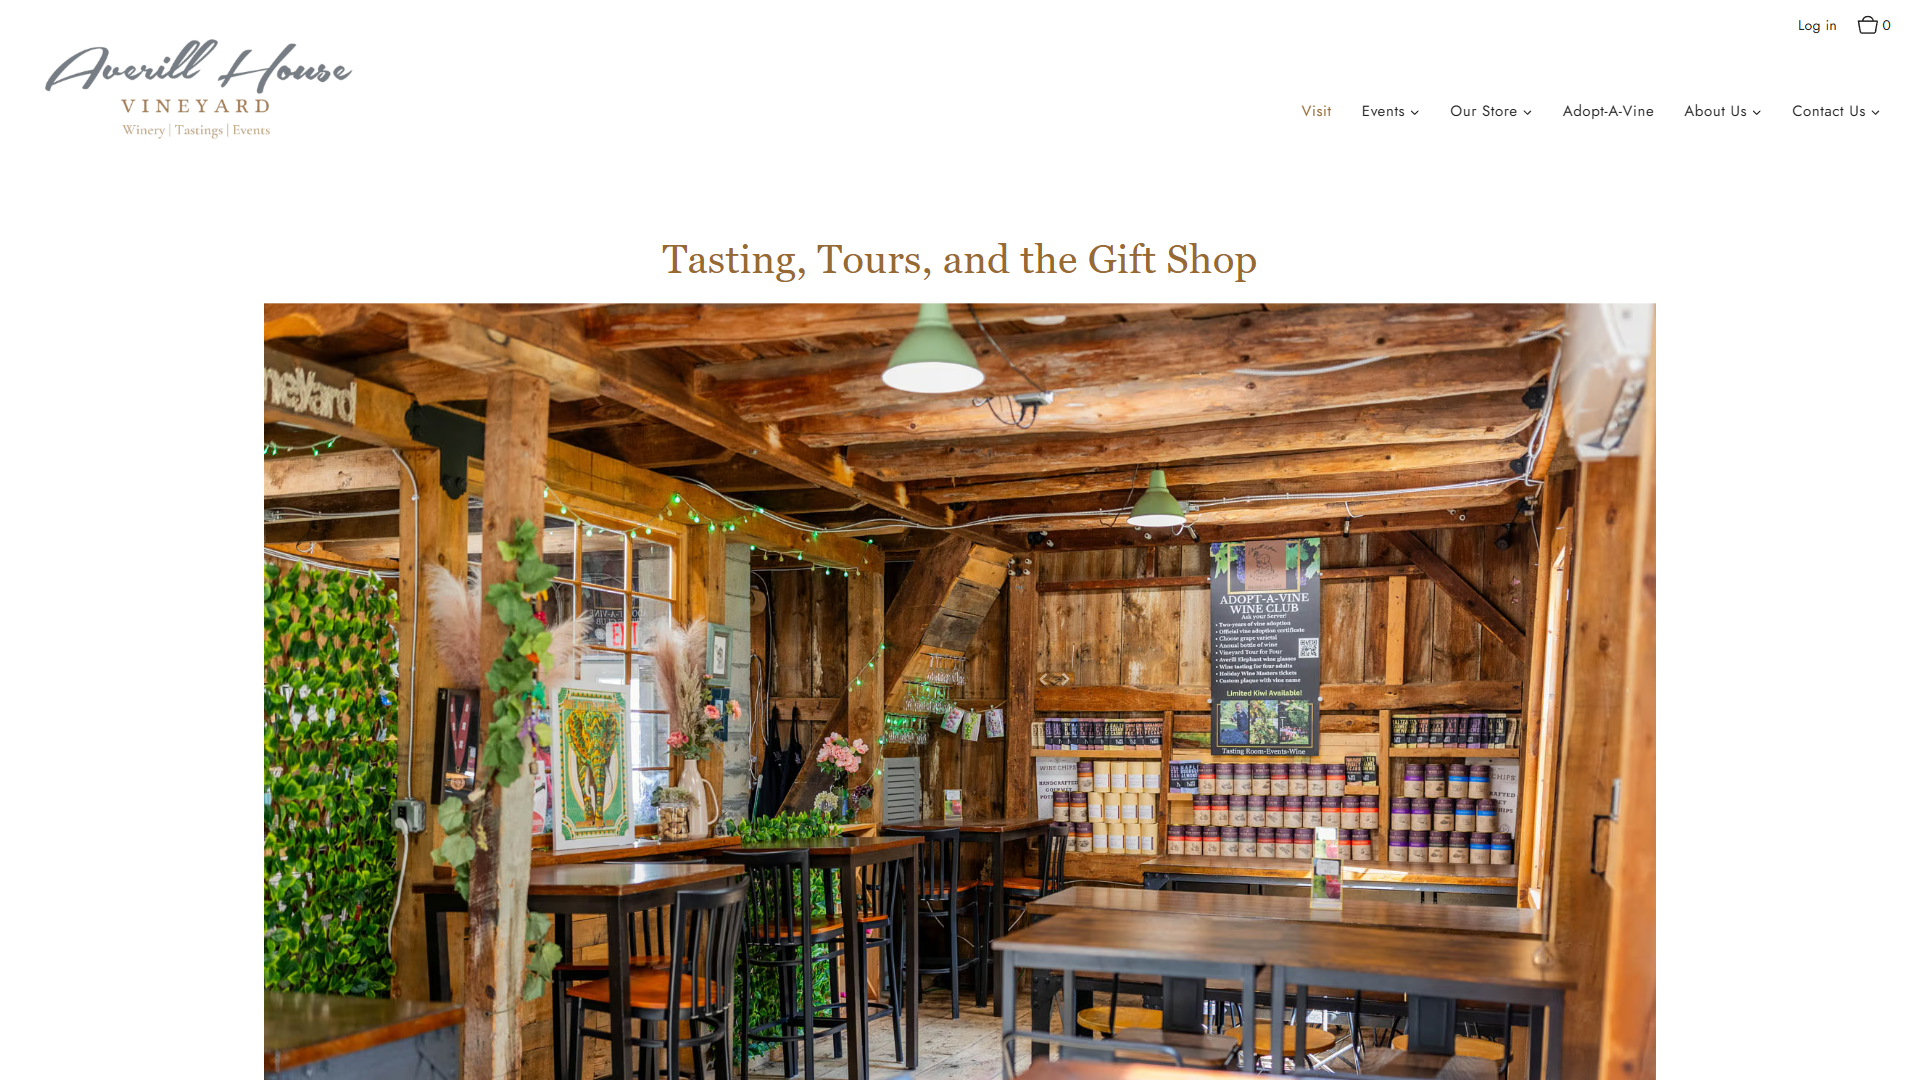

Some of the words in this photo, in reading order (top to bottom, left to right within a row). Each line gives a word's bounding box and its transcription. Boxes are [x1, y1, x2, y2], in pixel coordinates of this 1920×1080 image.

[1799, 20, 1821, 34] Log
[1826, 20, 1837, 31] in
[1882, 20, 1892, 31] 0
[45, 38, 219, 92] Averill
[217, 43, 353, 95] House
[121, 98, 270, 114] VINEYARD
[1302, 104, 1332, 117] Visit
[1362, 104, 1405, 117] Events
[1450, 104, 1478, 117] Our
[1482, 104, 1518, 117] Store
[1563, 104, 1654, 120] Adopt-A-Vine
[1684, 104, 1726, 117] About
[1731, 104, 1747, 117] Us
[1792, 104, 1845, 117] Contact
[1850, 104, 1866, 117] Us
[122, 124, 166, 139] Winery
[175, 124, 224, 139] Tastings
[232, 124, 271, 136] Events
[662, 243, 806, 282] Tasting,
[817, 244, 932, 281] Tours,
[944, 243, 1011, 274] and
[1020, 243, 1078, 274] the
[1089, 243, 1157, 274] Gift
[1168, 243, 1257, 283] Shop
[1220, 592, 1310, 604] ADOPT-A-VINE
[1230, 604, 1264, 614] WINE
[1266, 604, 1299, 613] CLUB
[612, 622, 638, 646] EXT
